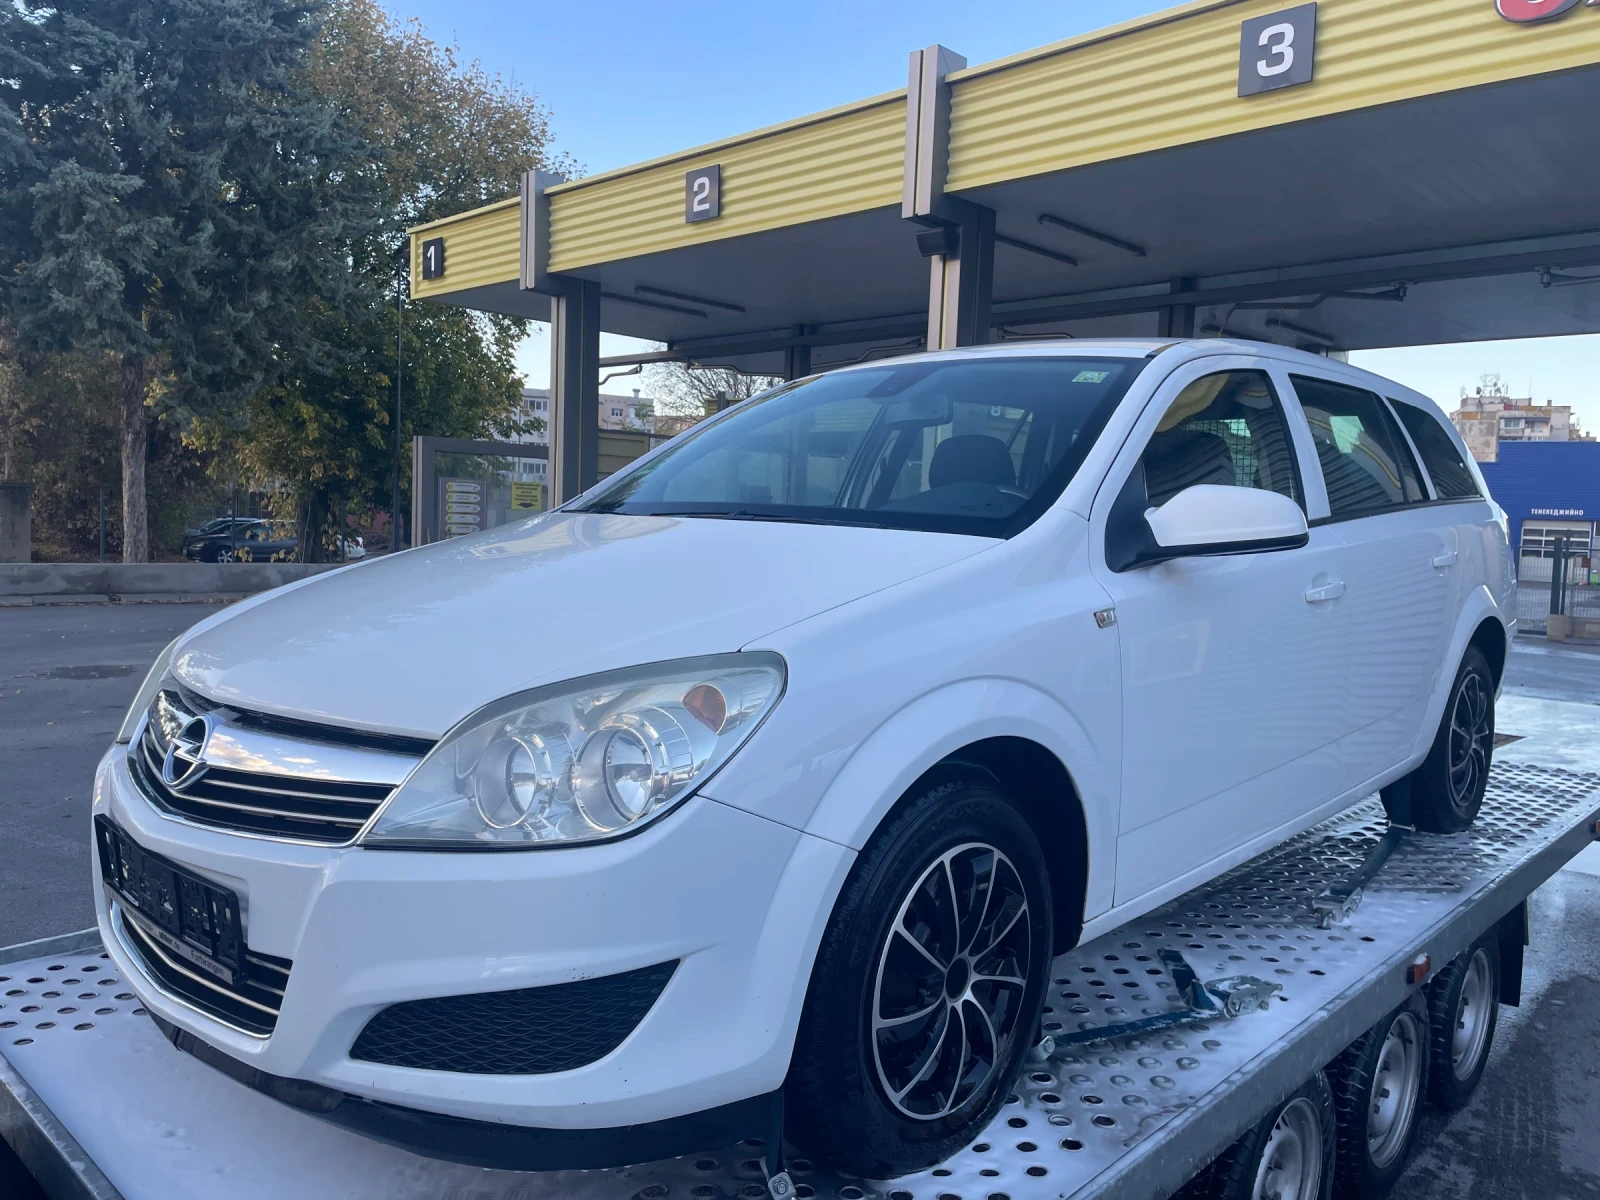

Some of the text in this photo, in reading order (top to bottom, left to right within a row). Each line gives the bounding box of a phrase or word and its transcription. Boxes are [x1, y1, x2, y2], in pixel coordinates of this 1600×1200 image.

[1257, 23, 1295, 77] 3
[693, 176, 710, 212] 2
[426, 245, 435, 271] 1
[1531, 508, 1584, 516] ТЕНЕКЕДЖИЙНО
